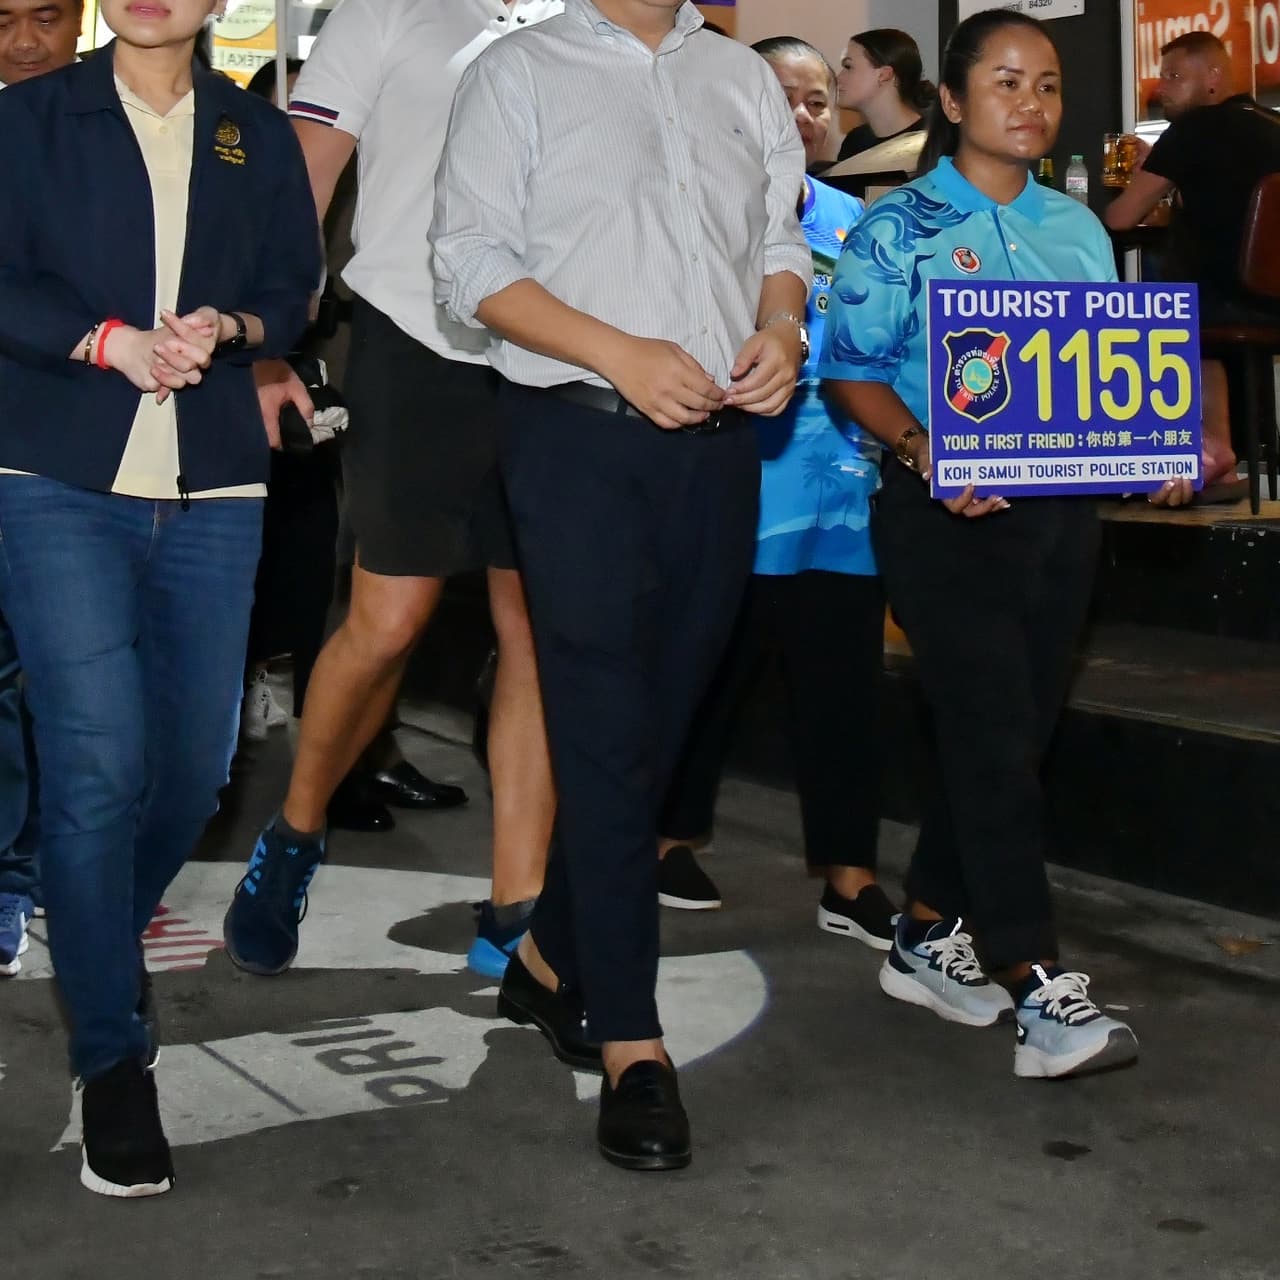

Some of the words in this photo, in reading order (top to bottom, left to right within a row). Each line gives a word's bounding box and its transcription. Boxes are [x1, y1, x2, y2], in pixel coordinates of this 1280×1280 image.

[938, 289, 1071, 318] TOURIST
[1085, 291, 1191, 319] POLICE
[1018, 328, 1192, 421] 1155
[955, 379, 978, 402] TOURIST
[982, 379, 1000, 402] POLICE
[942, 434, 979, 451] YOUR
[985, 433, 1023, 450] FIRST
[1086, 429, 1192, 448] 你的第一个朋友
[944, 466, 972, 480] KOH
[978, 465, 1021, 479] SAMUI
[1028, 463, 1084, 478] TOURIST
[1090, 462, 1136, 477] POLICE
[1142, 461, 1192, 475] STATION
